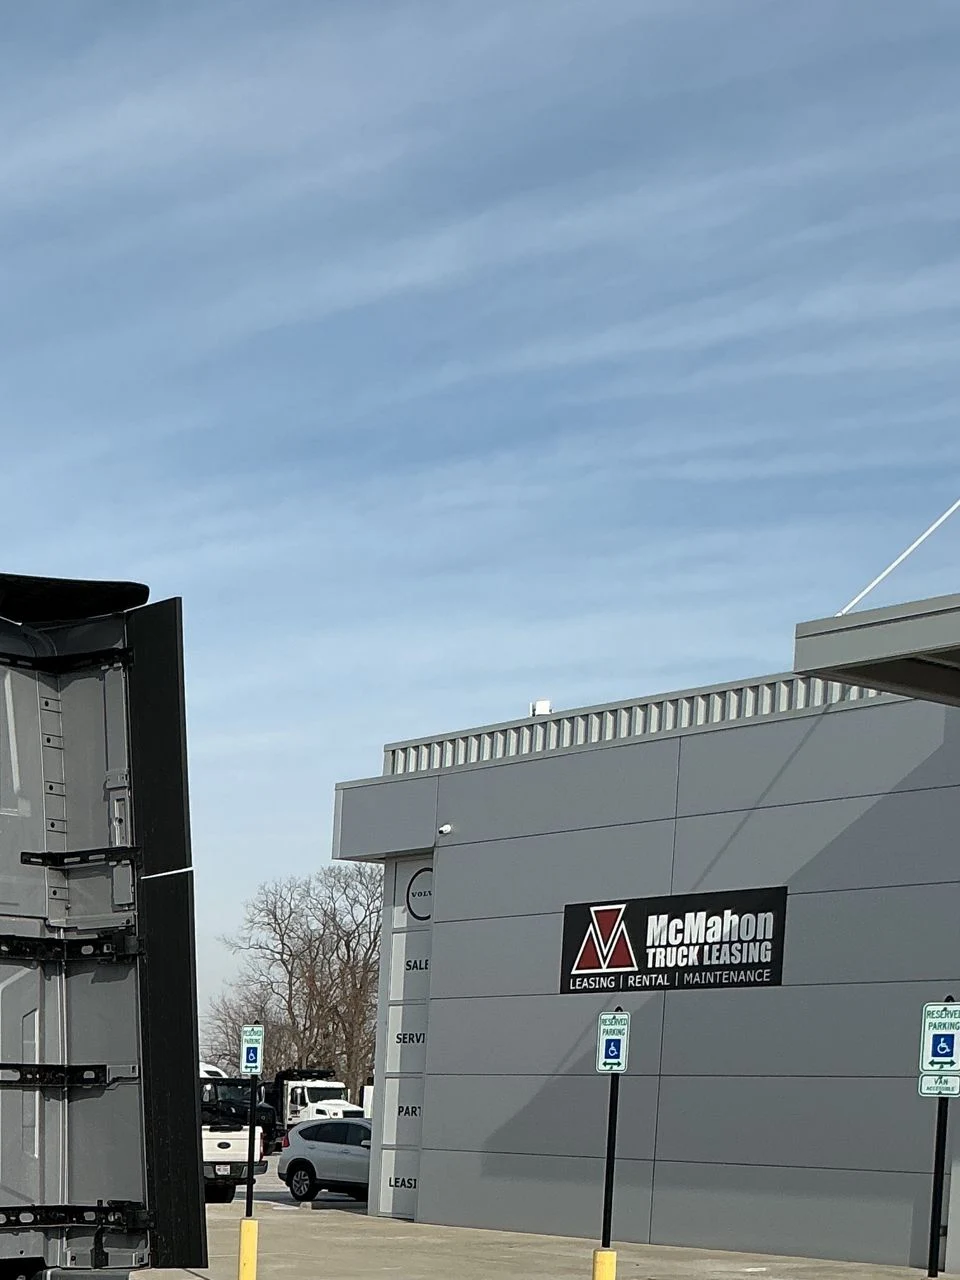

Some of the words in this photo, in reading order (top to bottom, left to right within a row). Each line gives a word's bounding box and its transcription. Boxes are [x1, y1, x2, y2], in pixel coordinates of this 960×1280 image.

[646, 910, 774, 946] McMahon
[646, 945, 699, 968] TRUCK
[702, 941, 772, 966] LEASING
[569, 975, 615, 990] LEASING
[627, 973, 670, 987] RENTAL
[683, 968, 771, 985] MAINTENANCE
[927, 1010, 960, 1019] RESERVE
[928, 1021, 960, 1031] PARKING
[934, 1078, 949, 1086] VAN
